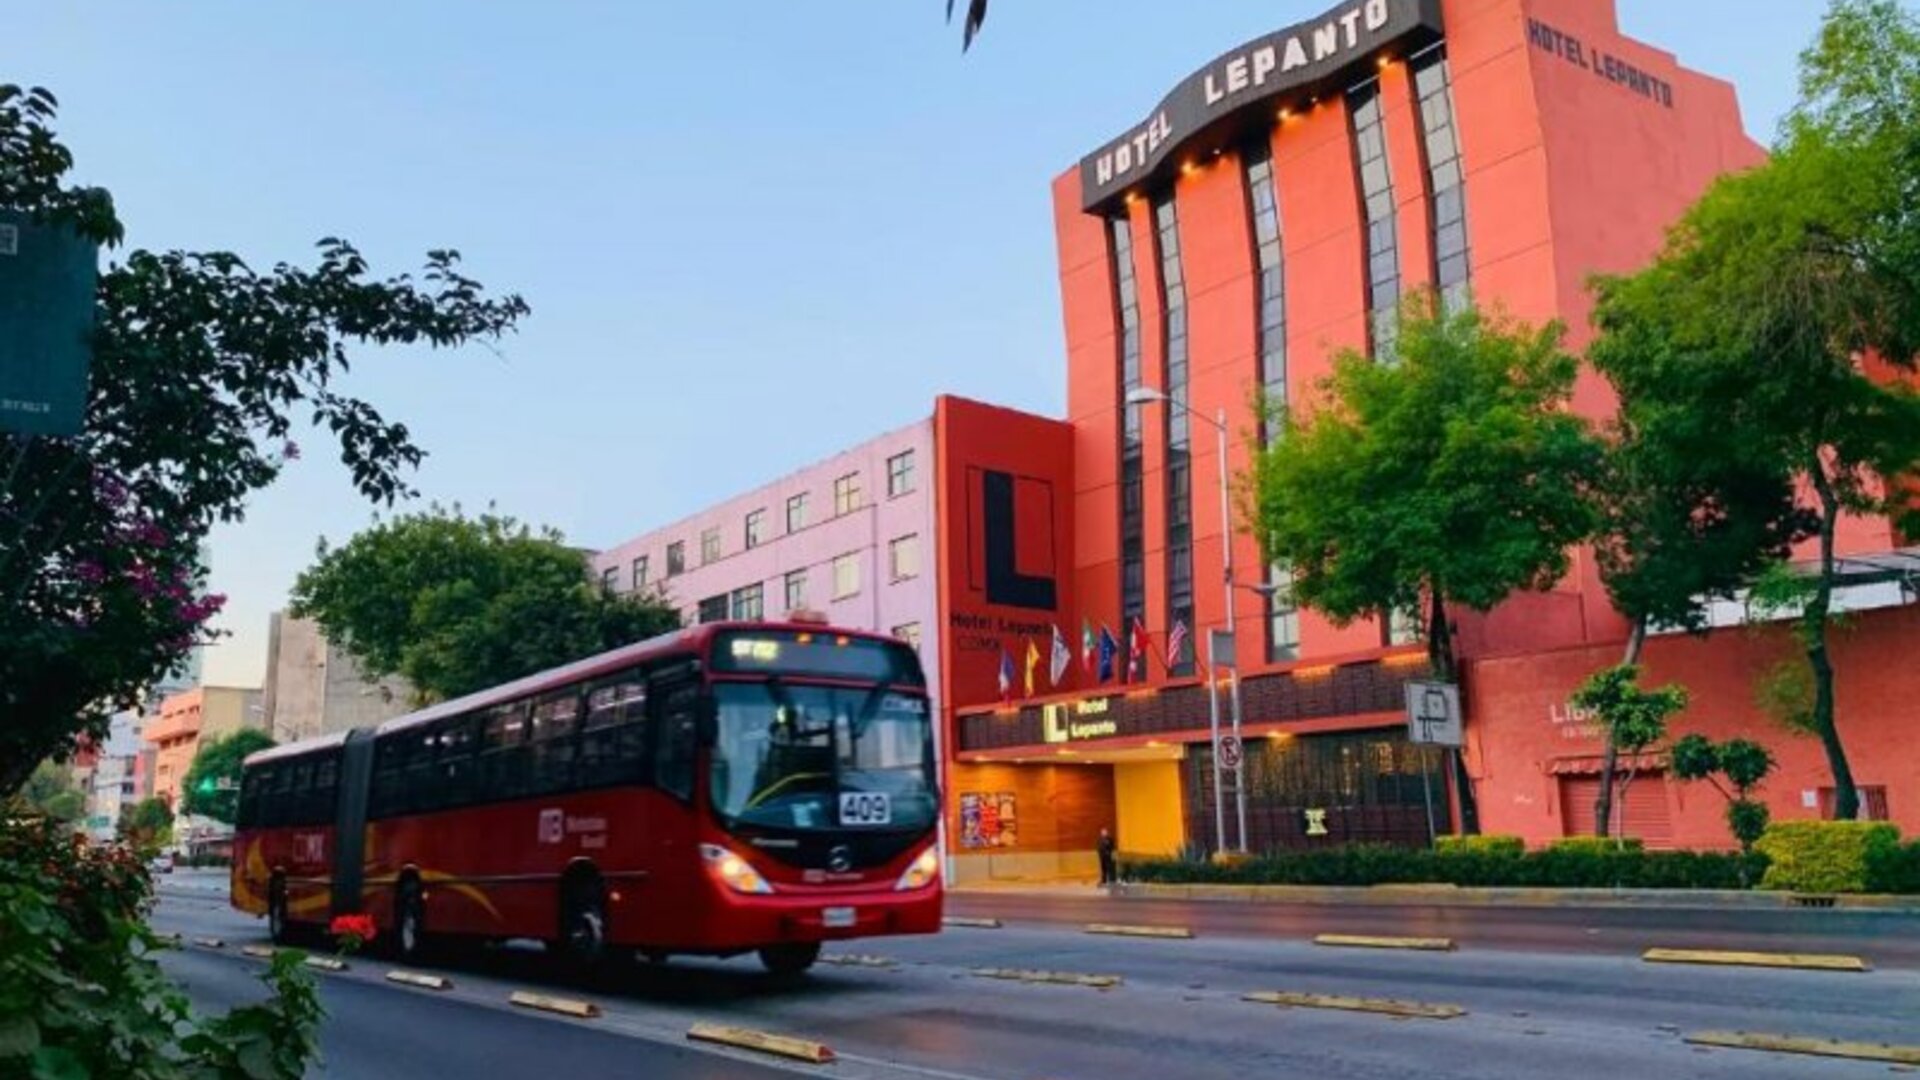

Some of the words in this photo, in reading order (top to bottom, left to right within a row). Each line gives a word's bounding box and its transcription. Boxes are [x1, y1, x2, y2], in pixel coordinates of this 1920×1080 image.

[1528, 17, 1588, 70] HOTEL
[1591, 49, 1673, 109] LEPANTO
[1096, 110, 1172, 186] HOTEL
[1204, 0, 1389, 105] LEPANTO
[951, 613, 992, 629] Hotel
[843, 796, 887, 821] 409
